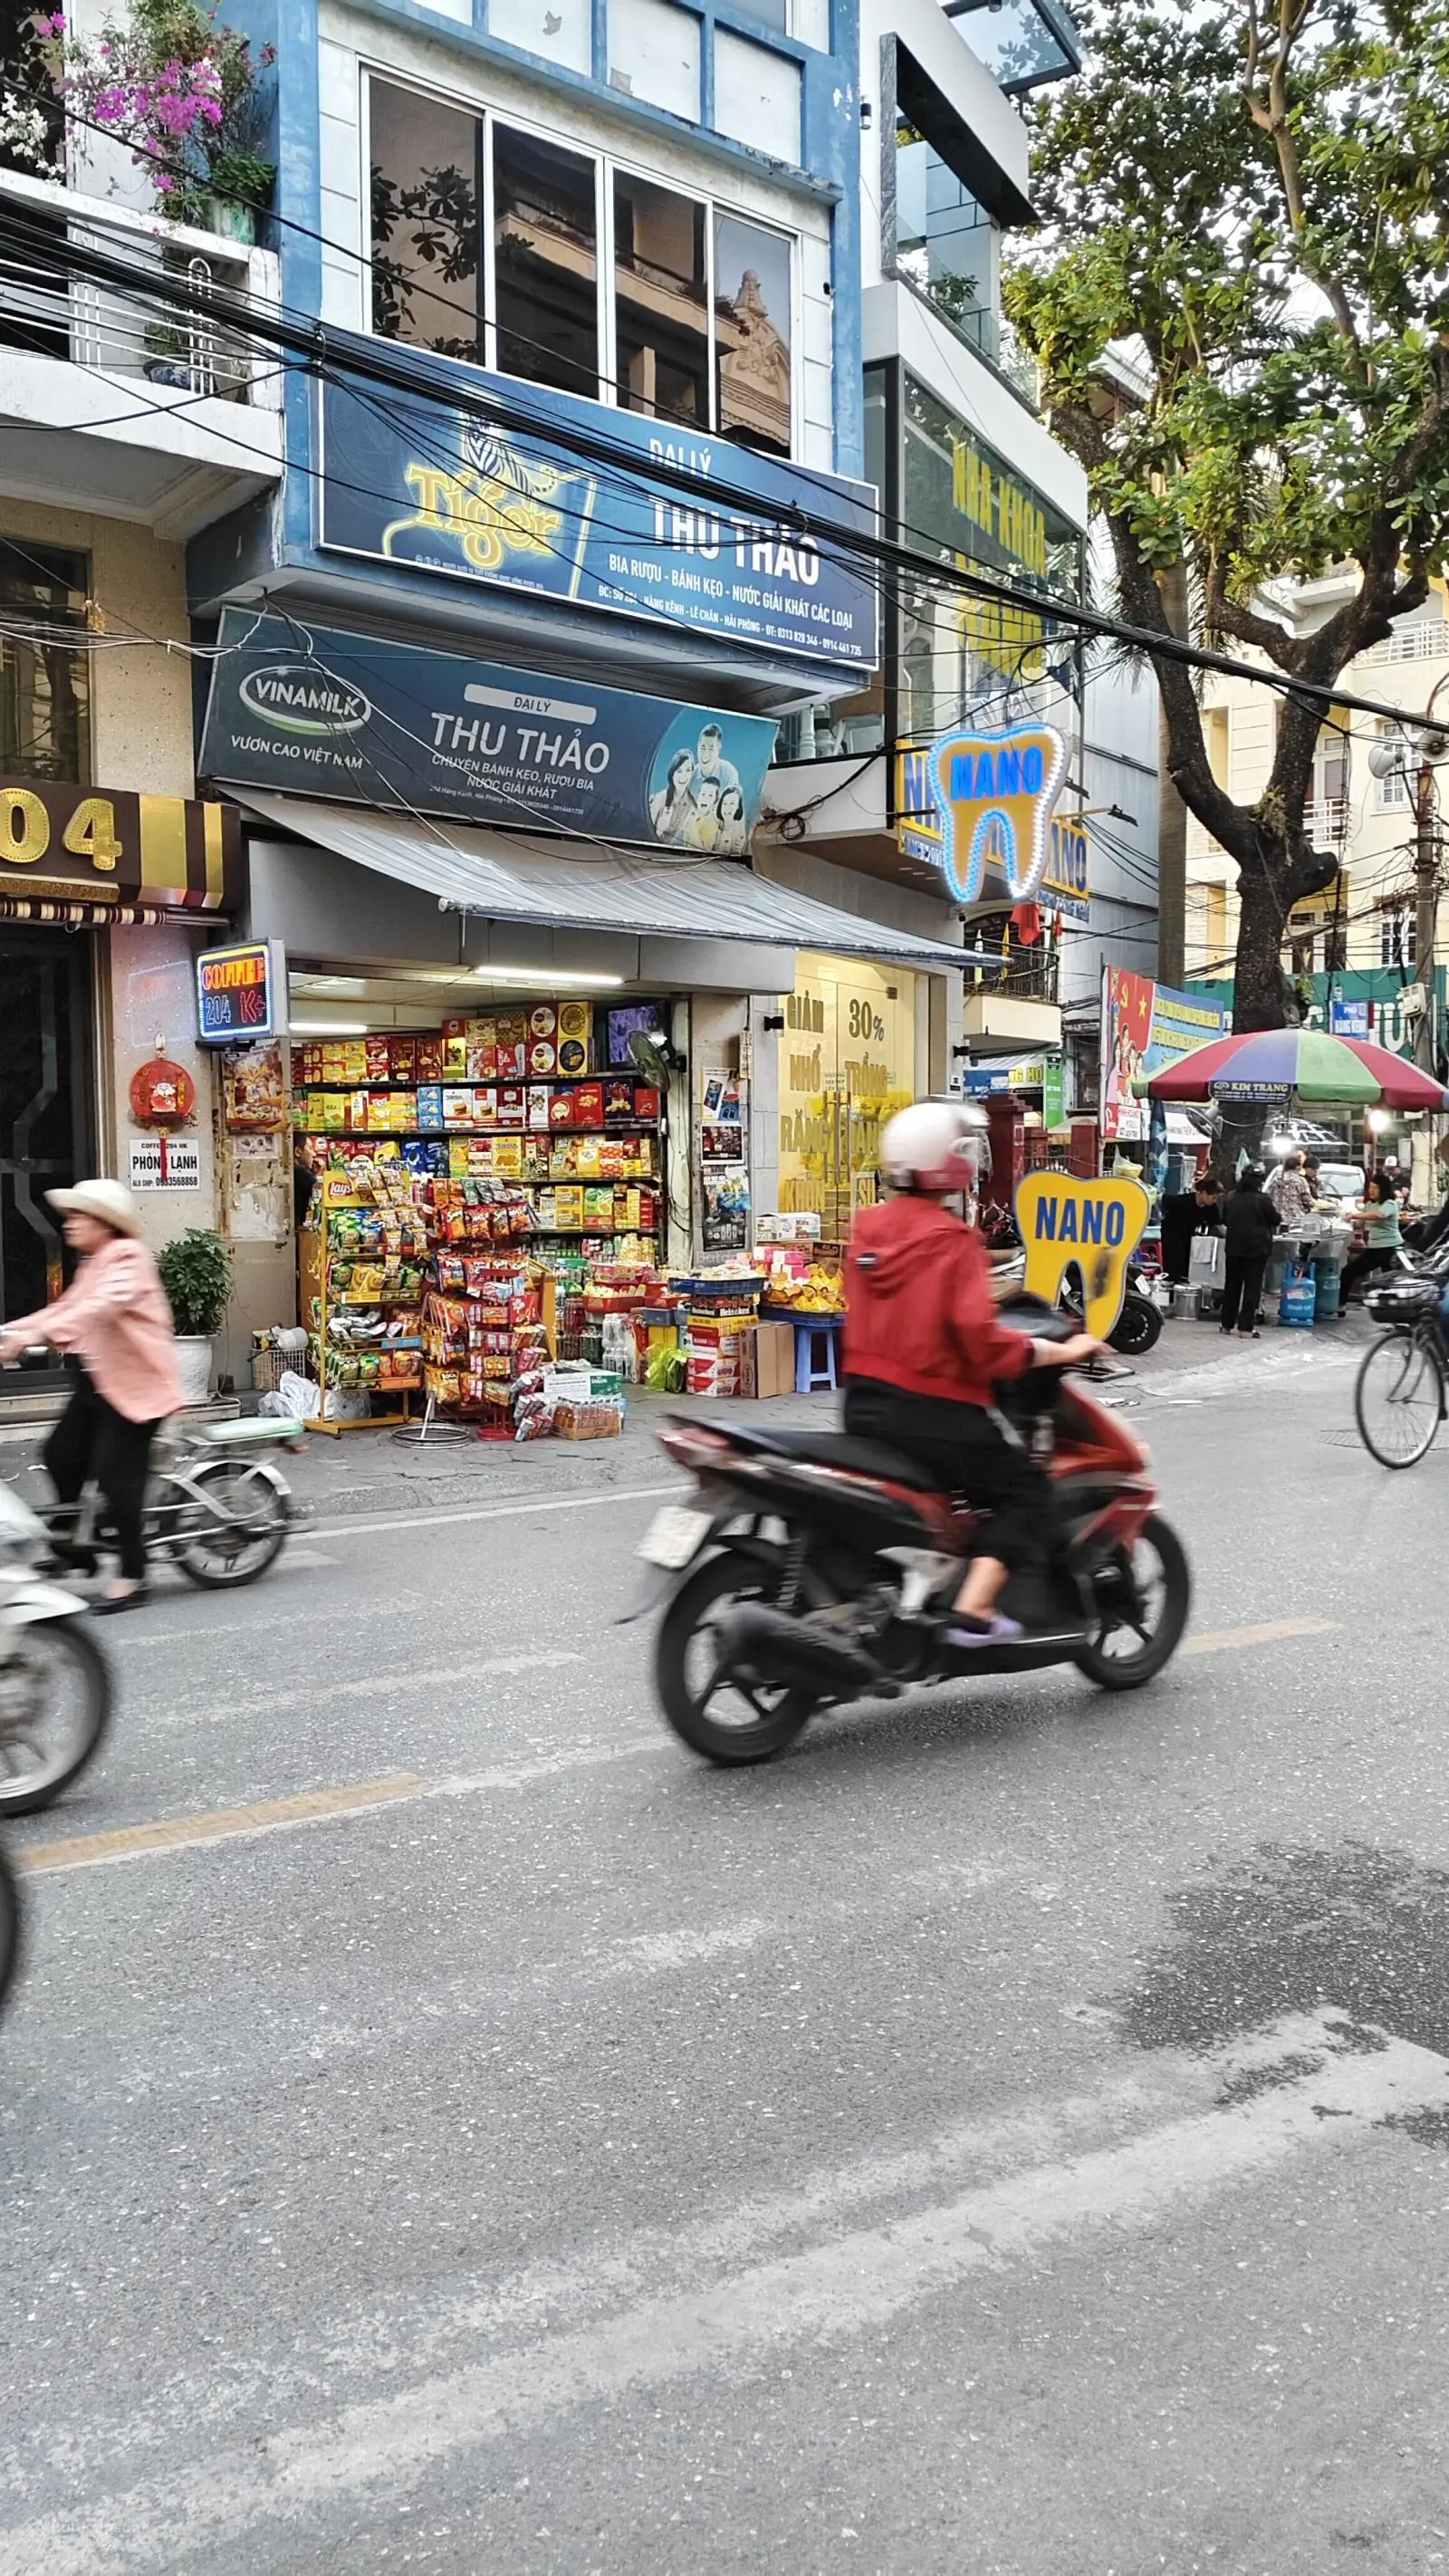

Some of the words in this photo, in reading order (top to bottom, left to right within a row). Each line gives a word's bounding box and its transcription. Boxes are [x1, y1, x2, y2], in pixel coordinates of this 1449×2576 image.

[408, 462, 561, 571] Tiger
[648, 495, 721, 560] THU
[999, 475, 1047, 578] KHOA
[609, 553, 629, 575] BIA
[630, 559, 662, 583] RƯỢU
[671, 568, 701, 592] BÁNH
[703, 577, 724, 599] KẸO
[732, 584, 761, 607] NƯỚC
[763, 590, 782, 612] GIẢI
[784, 597, 810, 619] KHÁT
[811, 602, 830, 624] CÁC
[831, 609, 853, 631] LOẠI
[255, 678, 361, 717] VINAMILK
[536, 700, 552, 713] LÝ
[231, 735, 271, 754] VƯƠN
[272, 742, 301, 758] CAO
[302, 747, 332, 764] VIỆT
[332, 754, 363, 769] NAM
[431, 711, 507, 755] THU
[516, 728, 610, 774] THẢO
[482, 764, 513, 777] BÁNH
[576, 779, 594, 791] BIA
[951, 745, 1043, 802] NANO
[202, 957, 264, 991] COFFEE
[206, 995, 232, 1025] 204
[239, 990, 266, 1024] K+
[849, 999, 885, 1042] 30%
[1232, 1082, 1252, 1091] KIM
[1253, 1083, 1289, 1092] TRANG
[132, 1152, 168, 1169] PHÒN
[170, 1156, 197, 1173] LẠNH
[1034, 1197, 1126, 1247] NANO
[719, 1306, 751, 1317] Heineken
